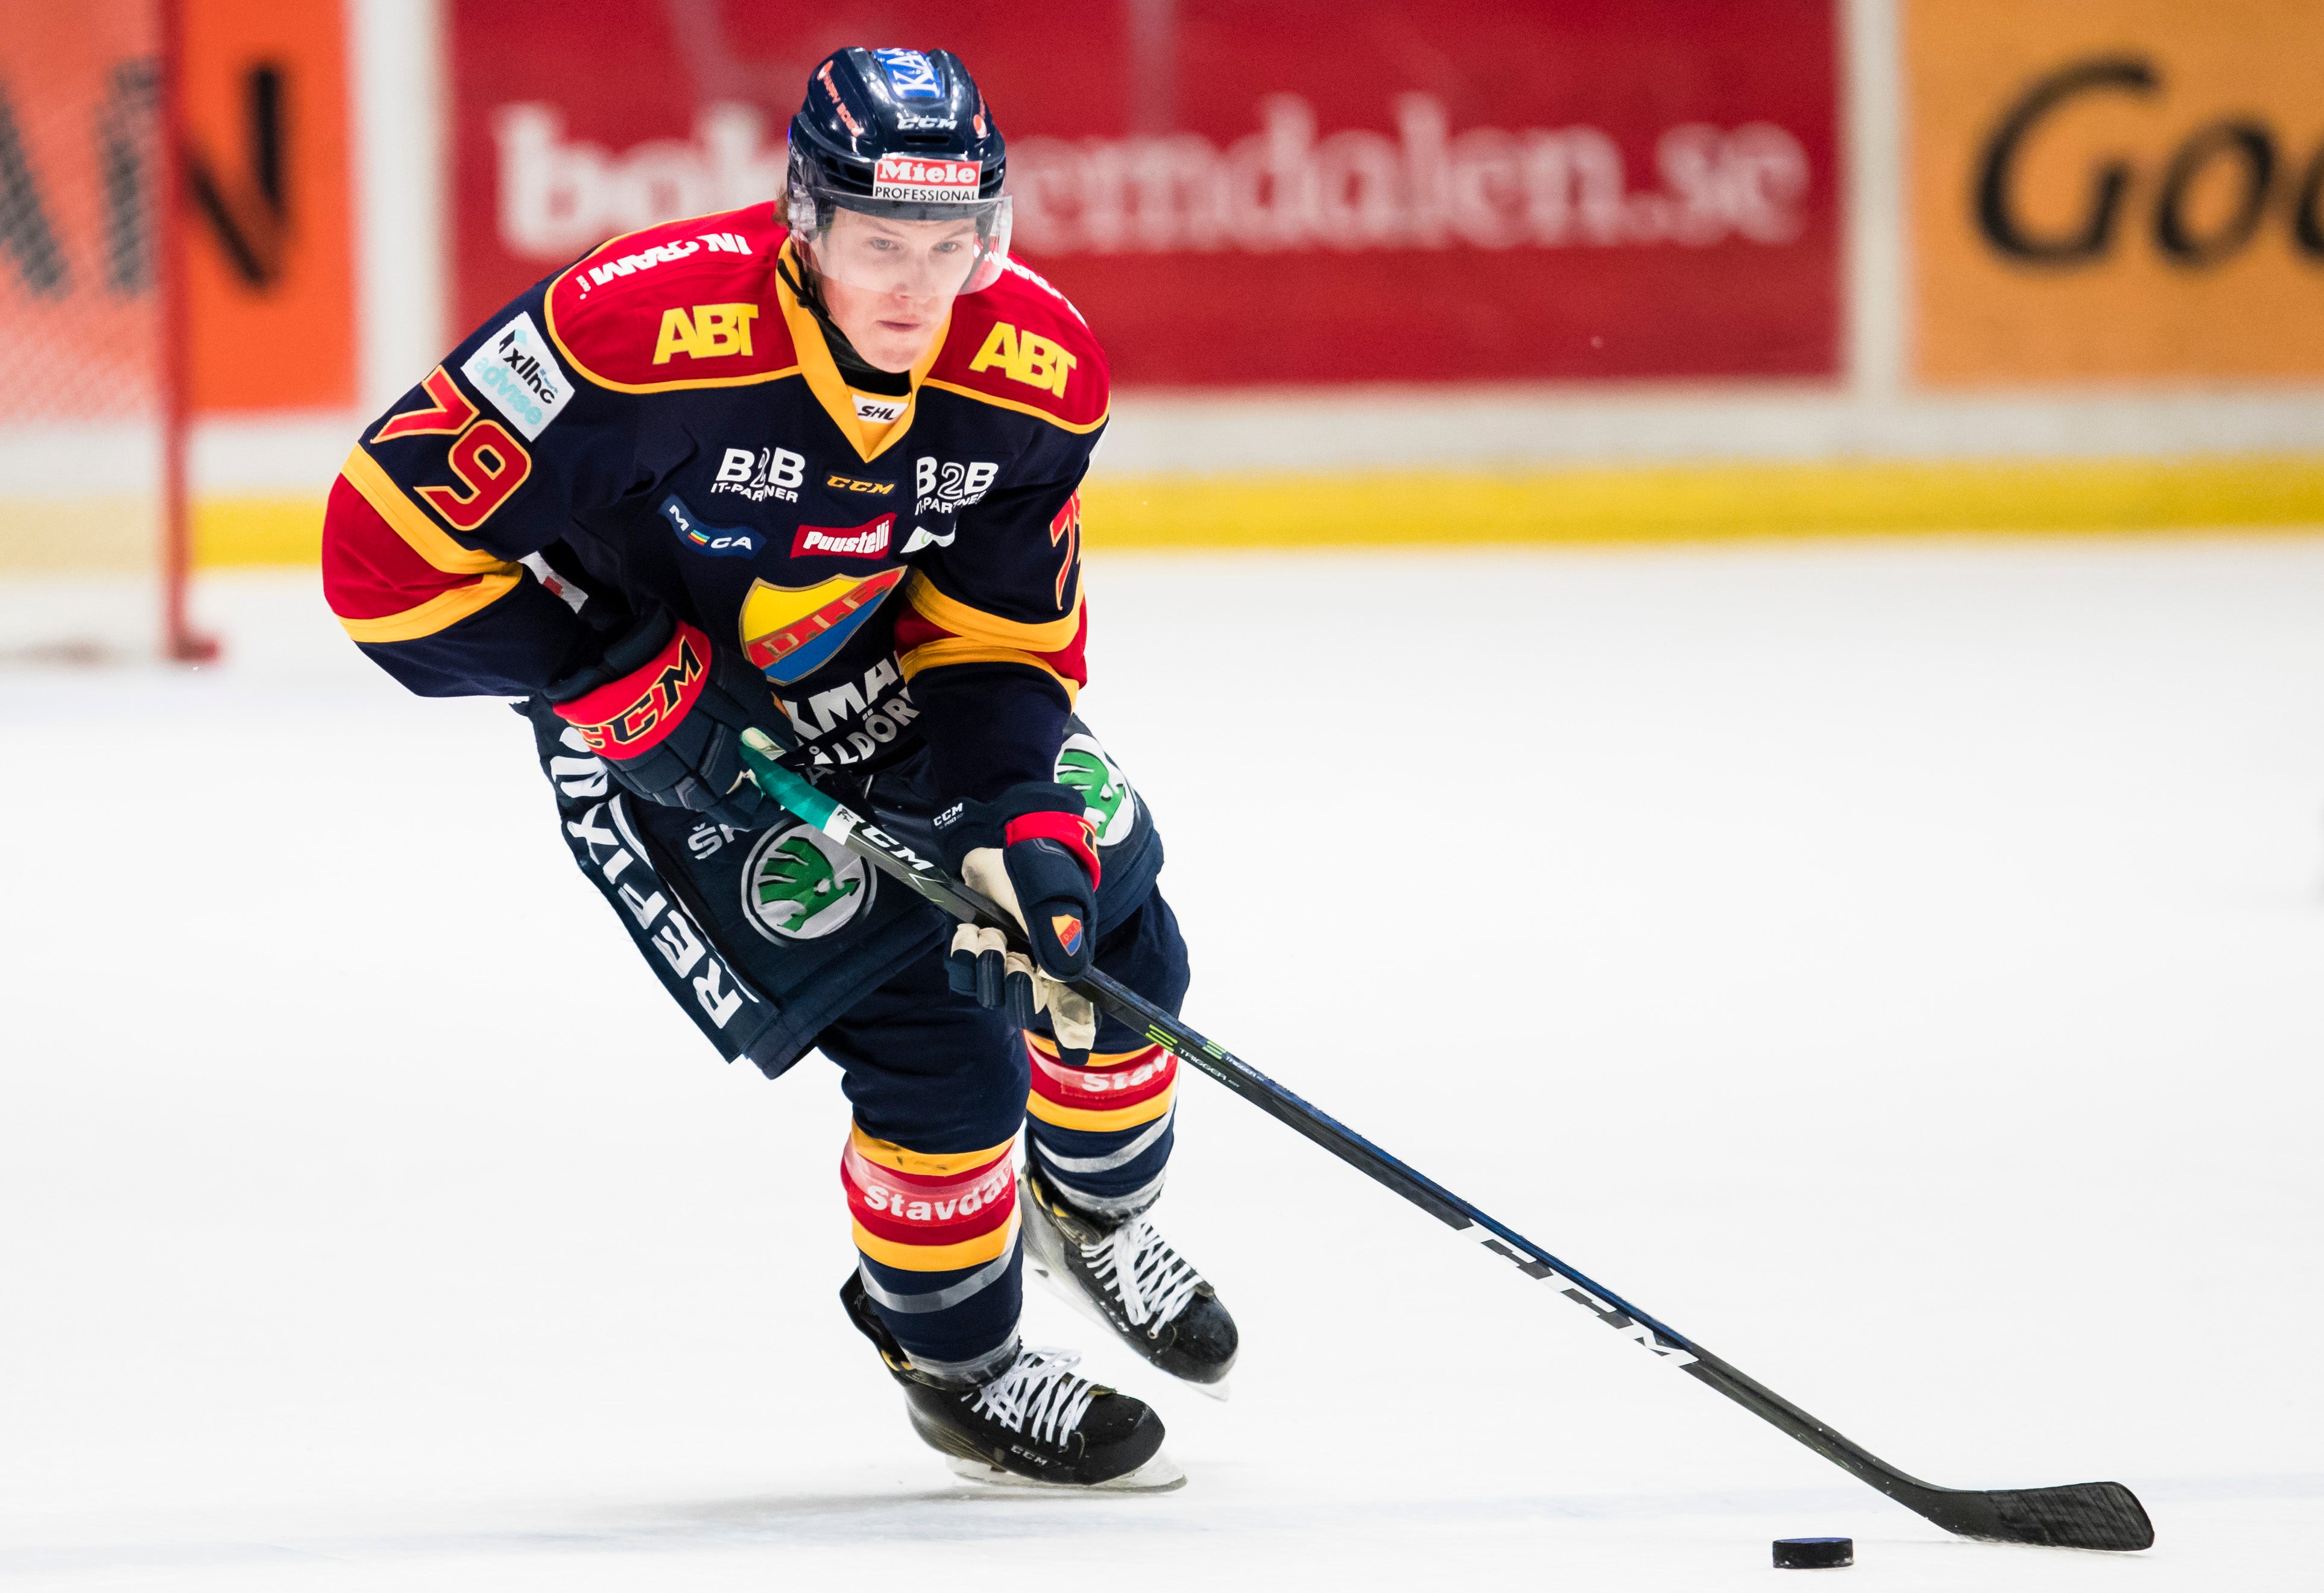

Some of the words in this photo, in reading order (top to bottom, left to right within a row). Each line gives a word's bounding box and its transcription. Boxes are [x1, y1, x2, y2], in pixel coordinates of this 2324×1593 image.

[897, 117, 958, 130] CCM
[879, 160, 976, 183] Miele
[875, 186, 976, 201] PROFESSIONAL
[652, 302, 759, 365] ABT
[968, 321, 1077, 400] ABT
[858, 406, 895, 421] SHL
[369, 364, 532, 531] 79
[715, 447, 806, 488] B2B
[827, 475, 895, 495] CCM
[916, 456, 999, 500] B2B
[710, 482, 799, 503] IT-PARNER
[803, 520, 889, 555] Puustelli
[1049, 484, 1083, 611] 7
[566, 635, 704, 749] CCM
[933, 803, 963, 827] CCM
[857, 816, 935, 871] CM
[1458, 1218, 1700, 1367] CCM
[1011, 1445, 1048, 1466] CCM
